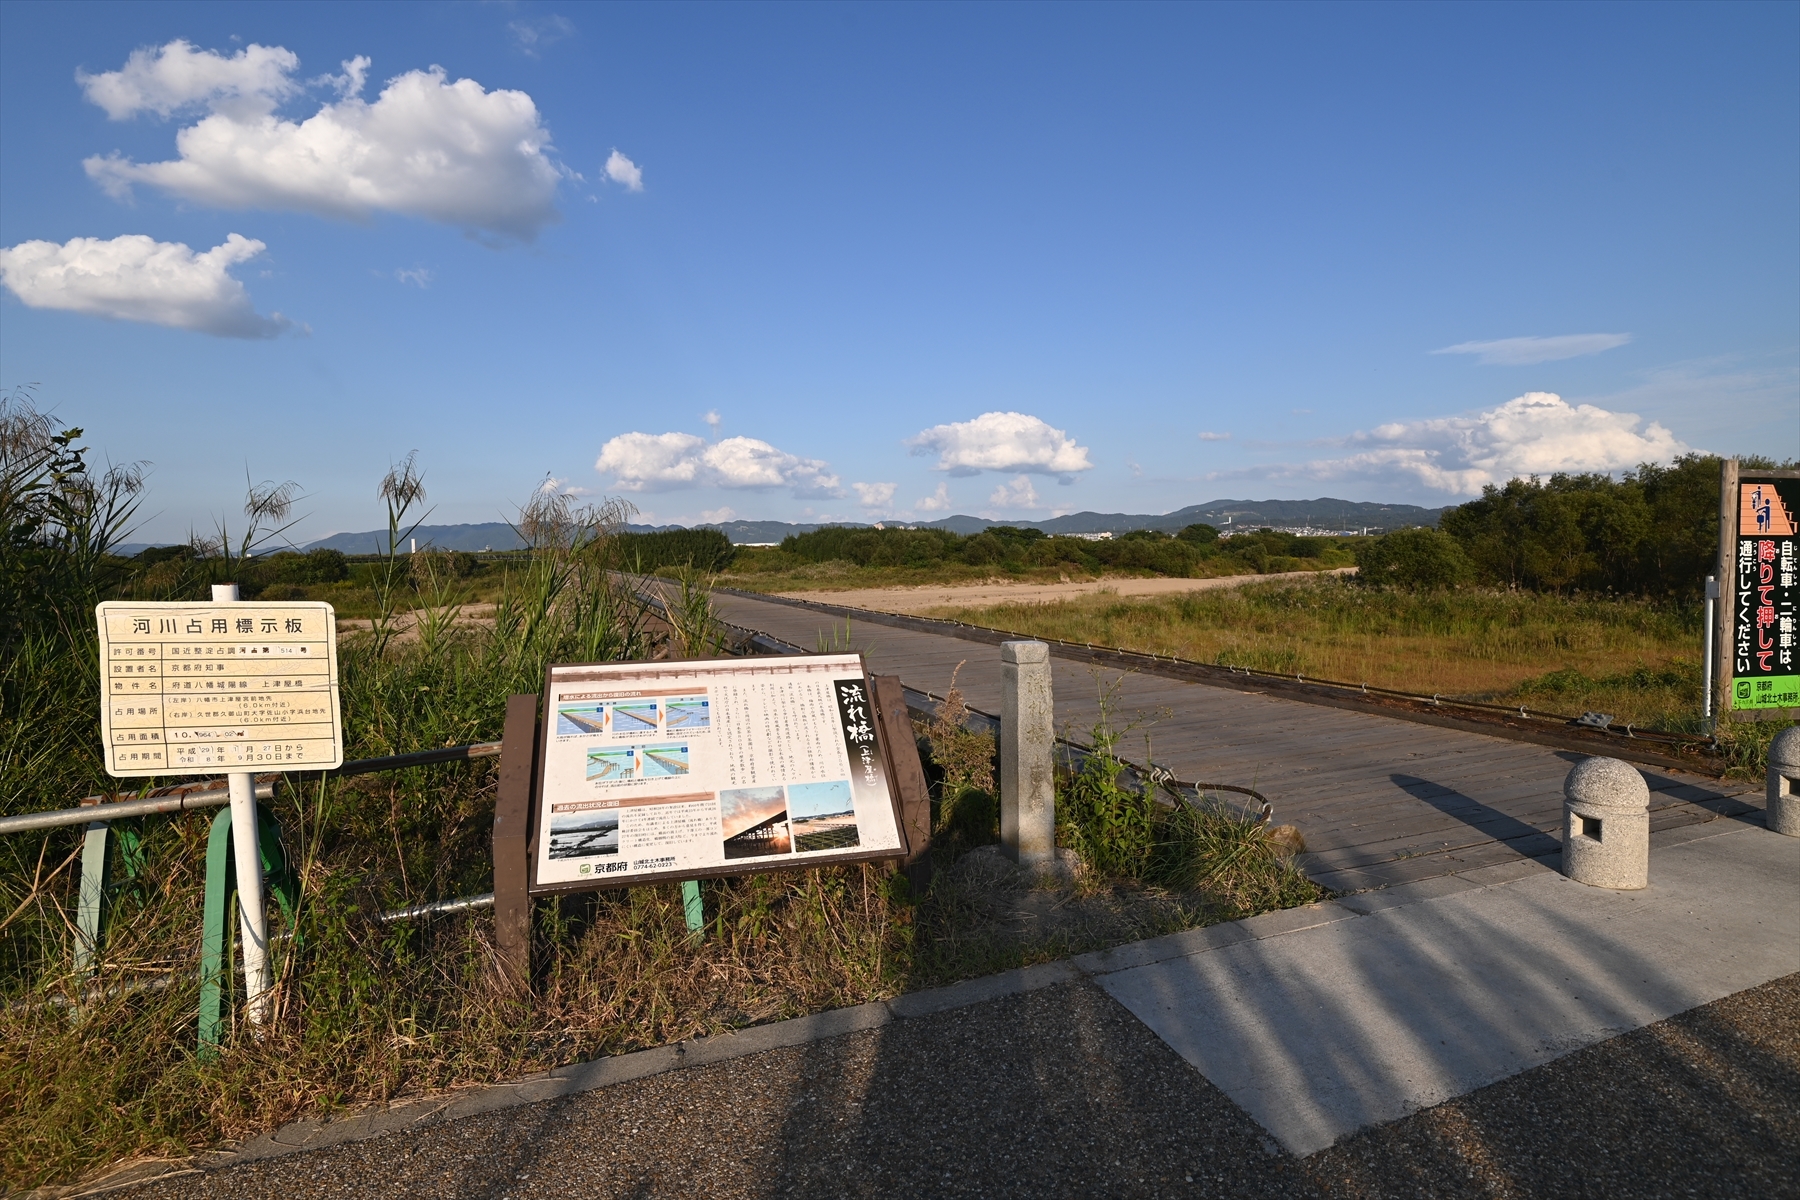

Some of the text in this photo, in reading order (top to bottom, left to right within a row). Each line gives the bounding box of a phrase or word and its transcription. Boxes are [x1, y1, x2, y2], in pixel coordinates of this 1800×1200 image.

[1737, 540, 1753, 672] 通行してください
[1757, 540, 1775, 671] 降りて押して
[1779, 540, 1792, 671] 自転車・二輪車は、
[133, 618, 303, 634] 河川占用標示板
[114, 647, 156, 656] 許可番号
[114, 665, 157, 673] 設置者名
[171, 664, 225, 672] 京都府知事
[115, 682, 158, 690] 物件名
[172, 680, 303, 689] 府道八幡城陽線 上津屋橋
[1756, 681, 1772, 691] 京都府
[115, 707, 159, 716] 占用場所
[841, 684, 874, 744] 流れ橋
[117, 732, 160, 741] 占用面積
[119, 752, 162, 761] 占用期間
[594, 861, 628, 874] 京都府
